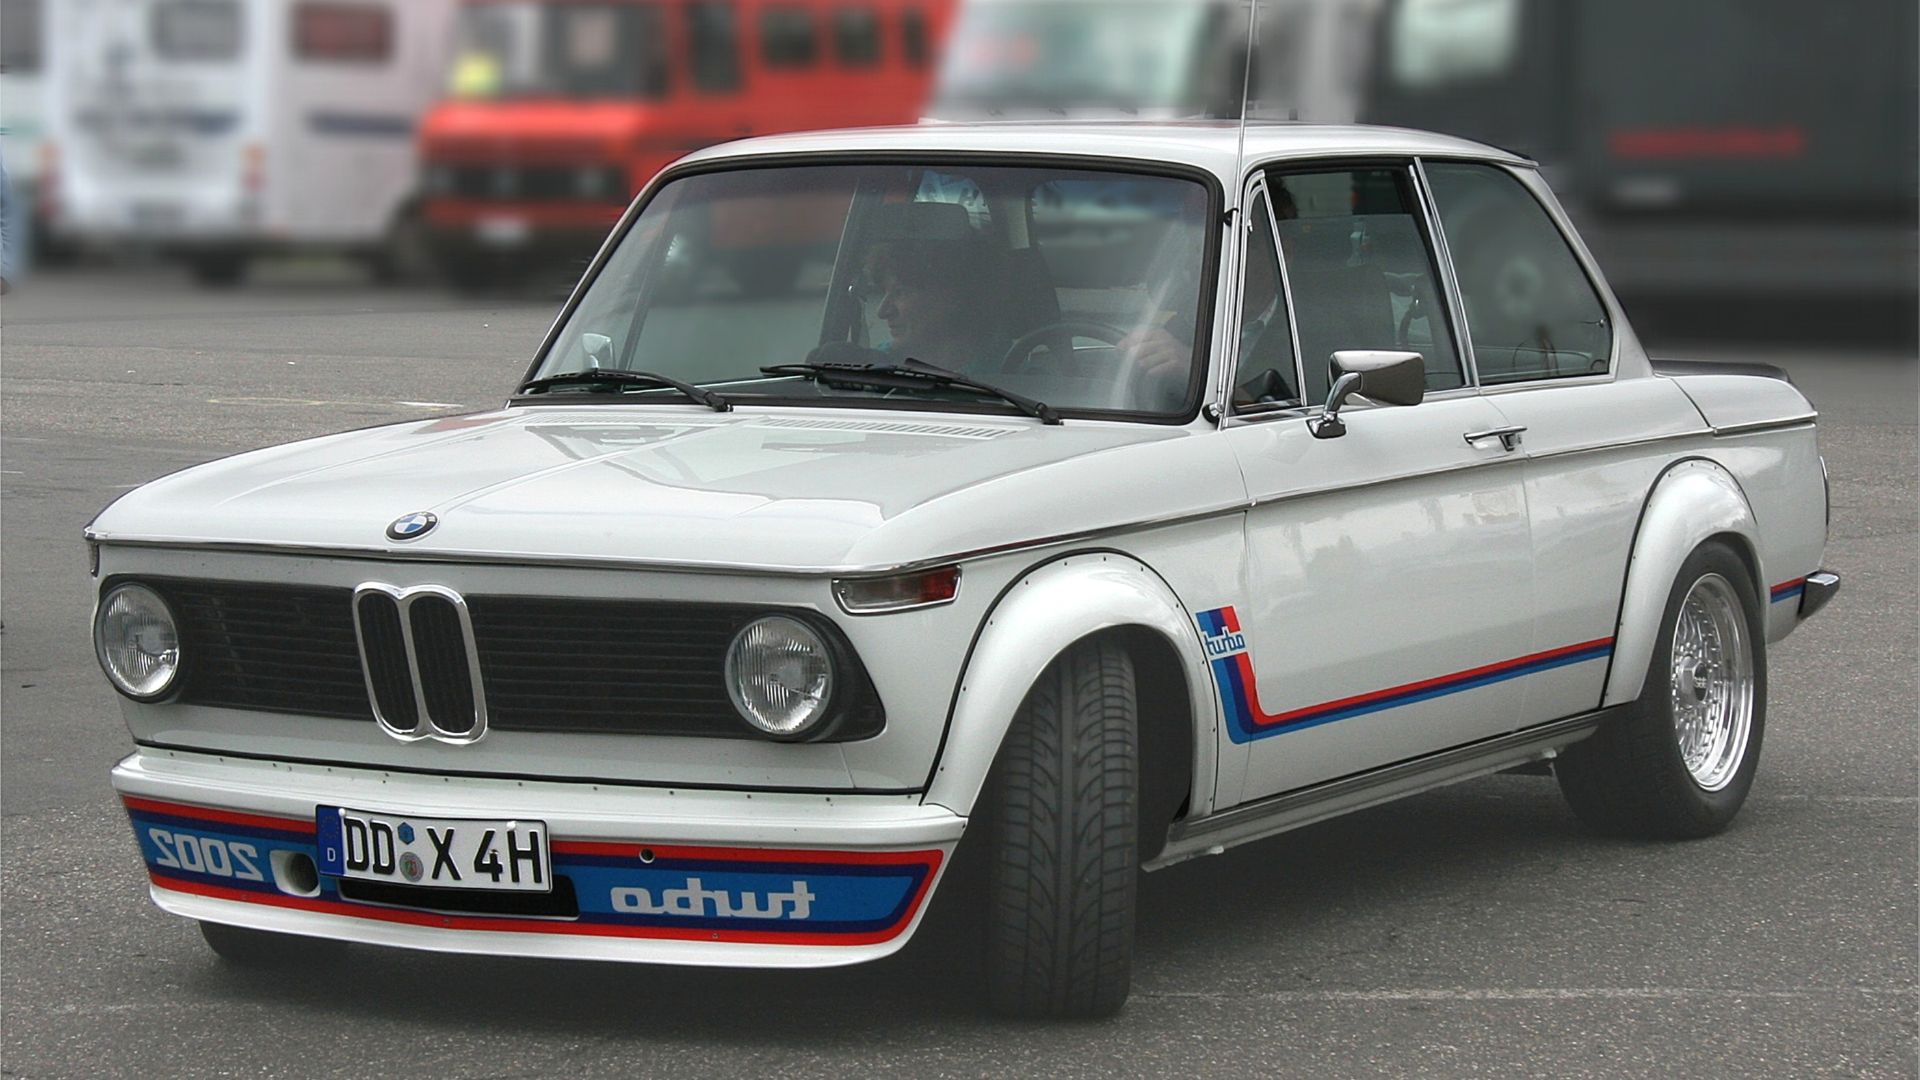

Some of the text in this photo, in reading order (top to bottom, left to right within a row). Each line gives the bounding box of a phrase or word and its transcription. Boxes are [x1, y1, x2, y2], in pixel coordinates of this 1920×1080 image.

[1203, 629, 1246, 656] turbo
[326, 847, 337, 863] D
[343, 816, 543, 884] DD X 4H
